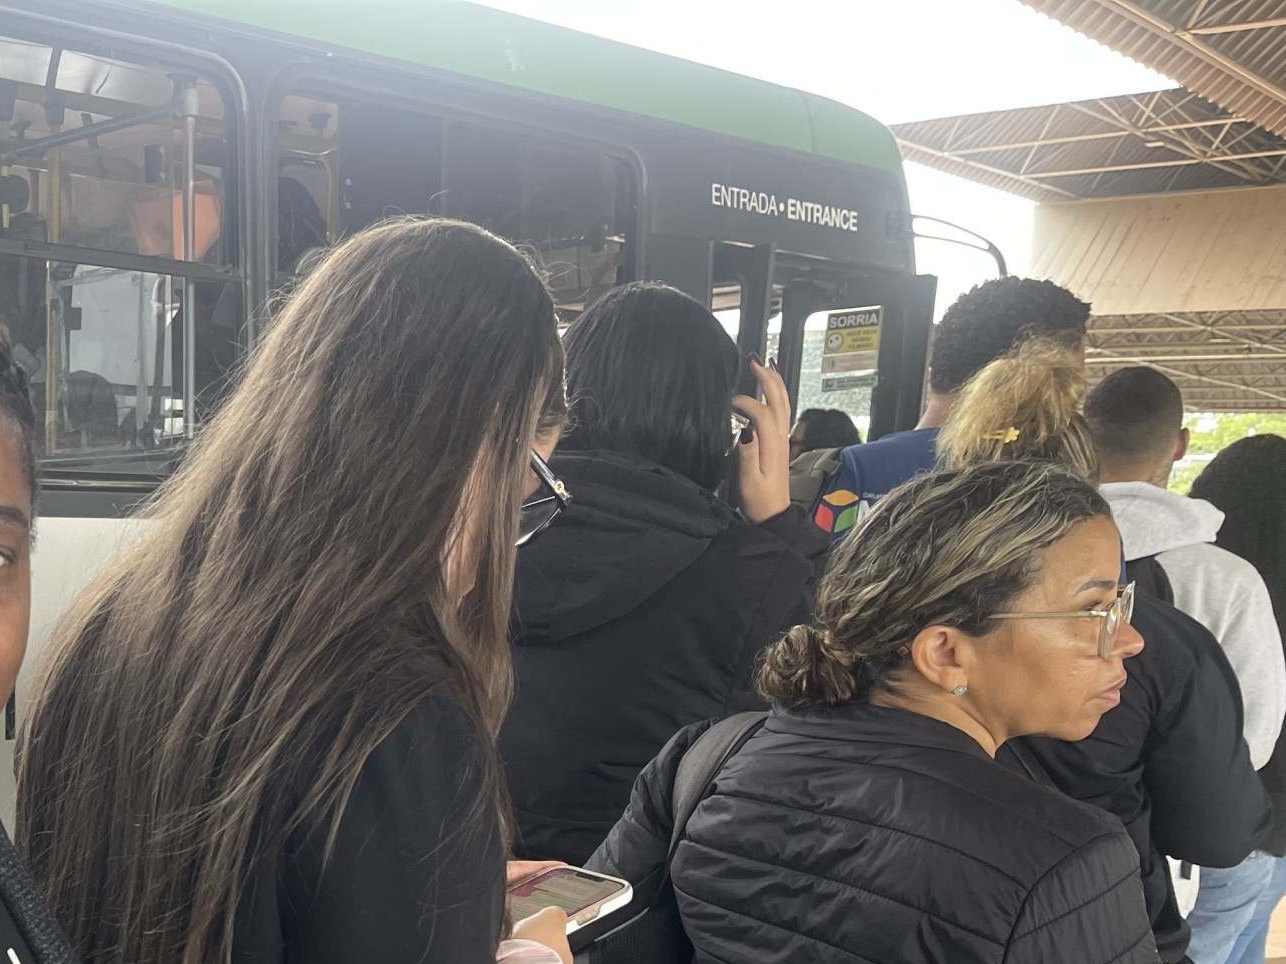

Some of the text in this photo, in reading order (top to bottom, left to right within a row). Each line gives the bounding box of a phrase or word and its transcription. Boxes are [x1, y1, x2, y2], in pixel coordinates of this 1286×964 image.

[711, 183, 858, 232] ENTRADA ENTRANCE
[829, 312, 878, 328] SORRIA
